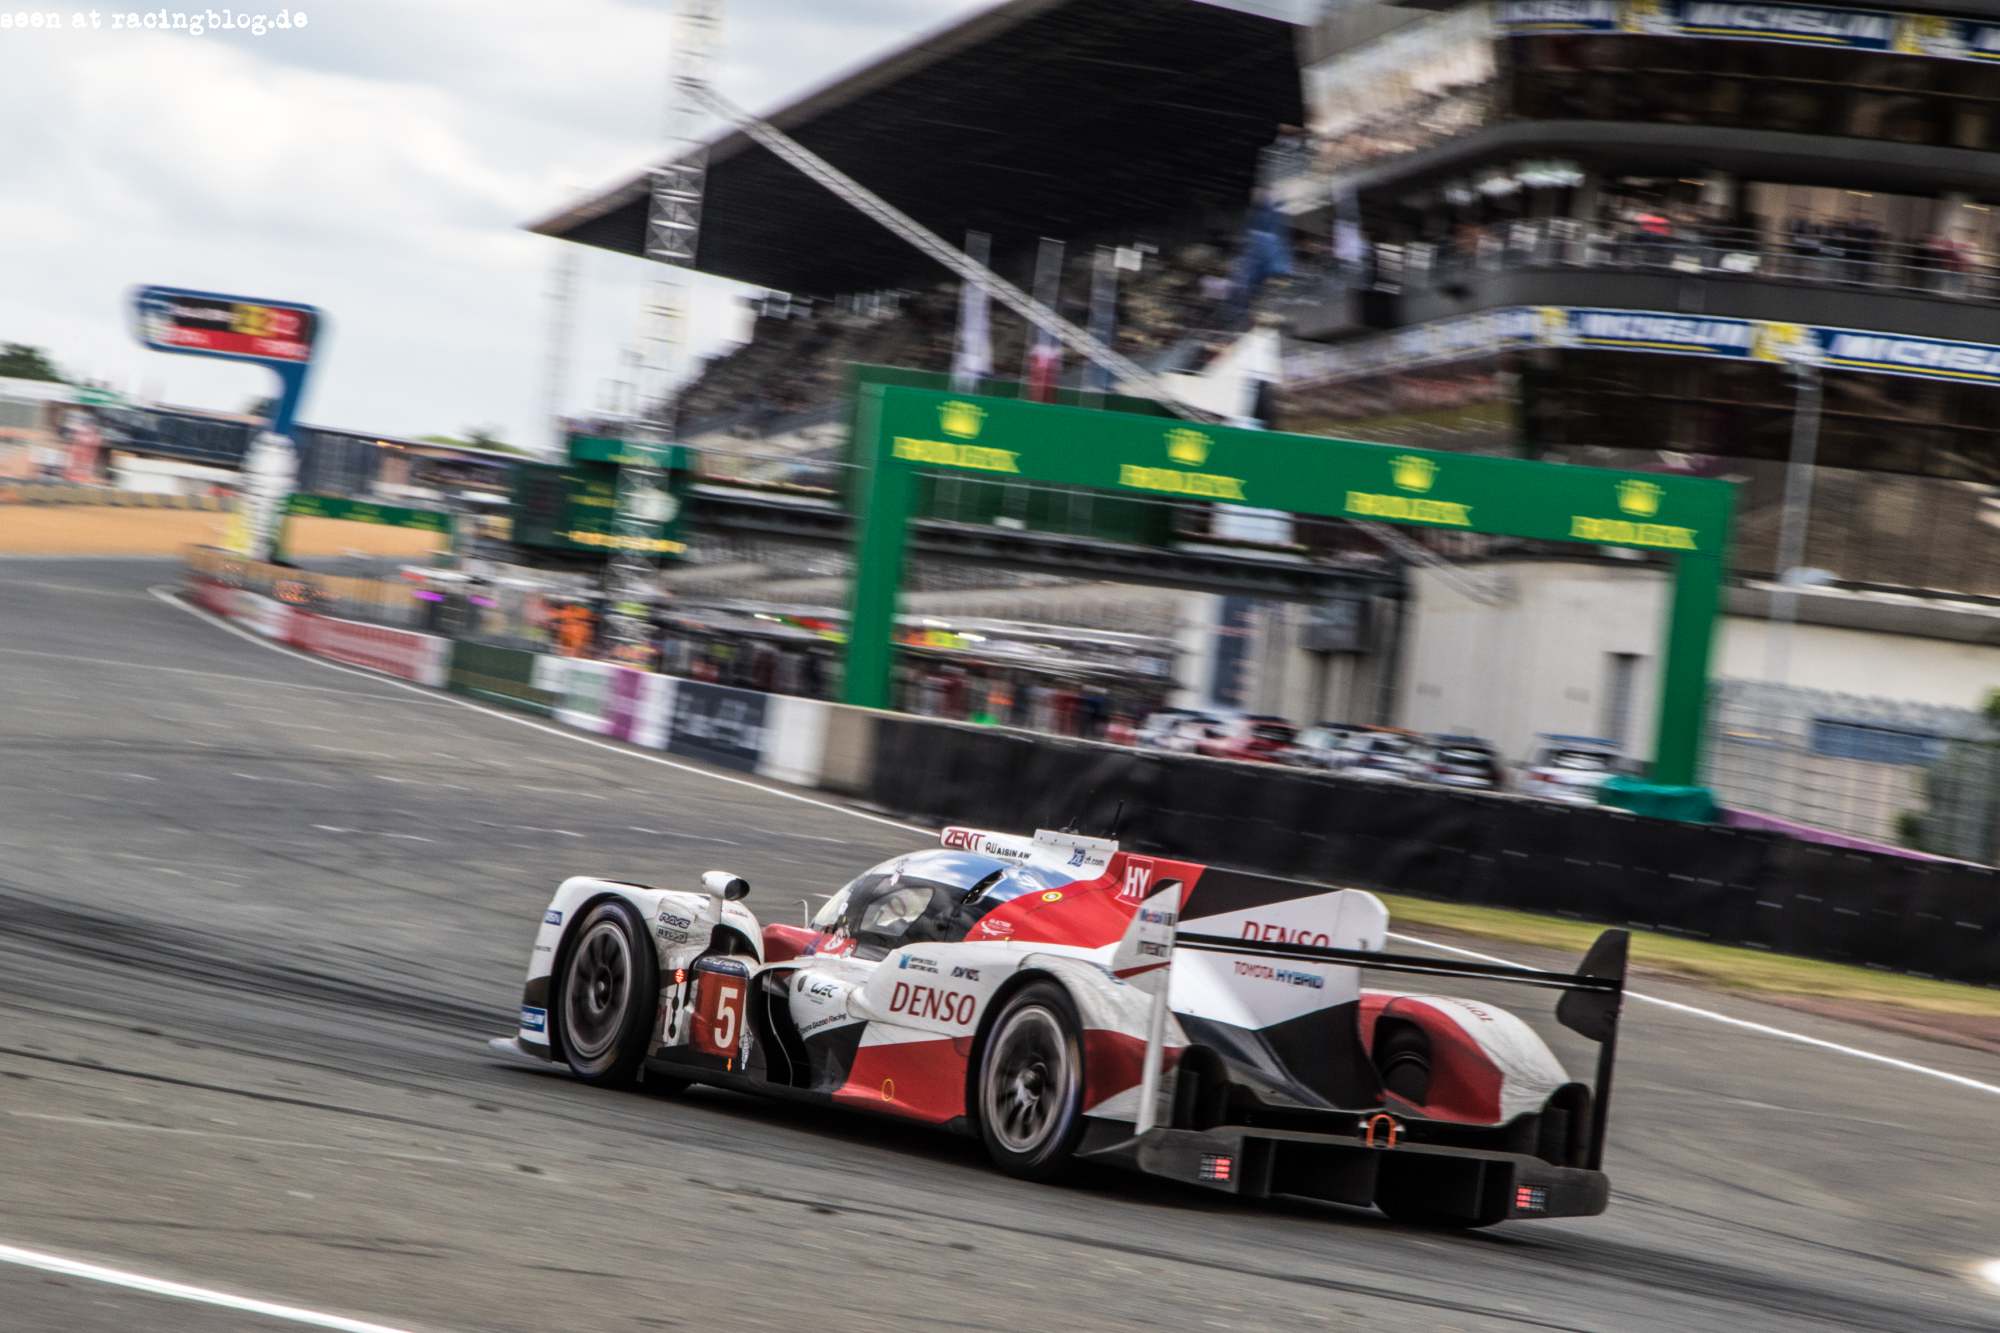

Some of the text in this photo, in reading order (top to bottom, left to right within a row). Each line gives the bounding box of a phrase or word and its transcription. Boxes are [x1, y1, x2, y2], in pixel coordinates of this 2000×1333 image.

[944, 829, 986, 850] ZENT
[996, 847, 1018, 858] AISIN
[1122, 866, 1151, 898] HY
[658, 912, 691, 929] RAYS
[1234, 961, 1325, 990] TOYOTA HYBRID
[714, 986, 739, 1049] 5
[889, 981, 977, 1025] DENSO
